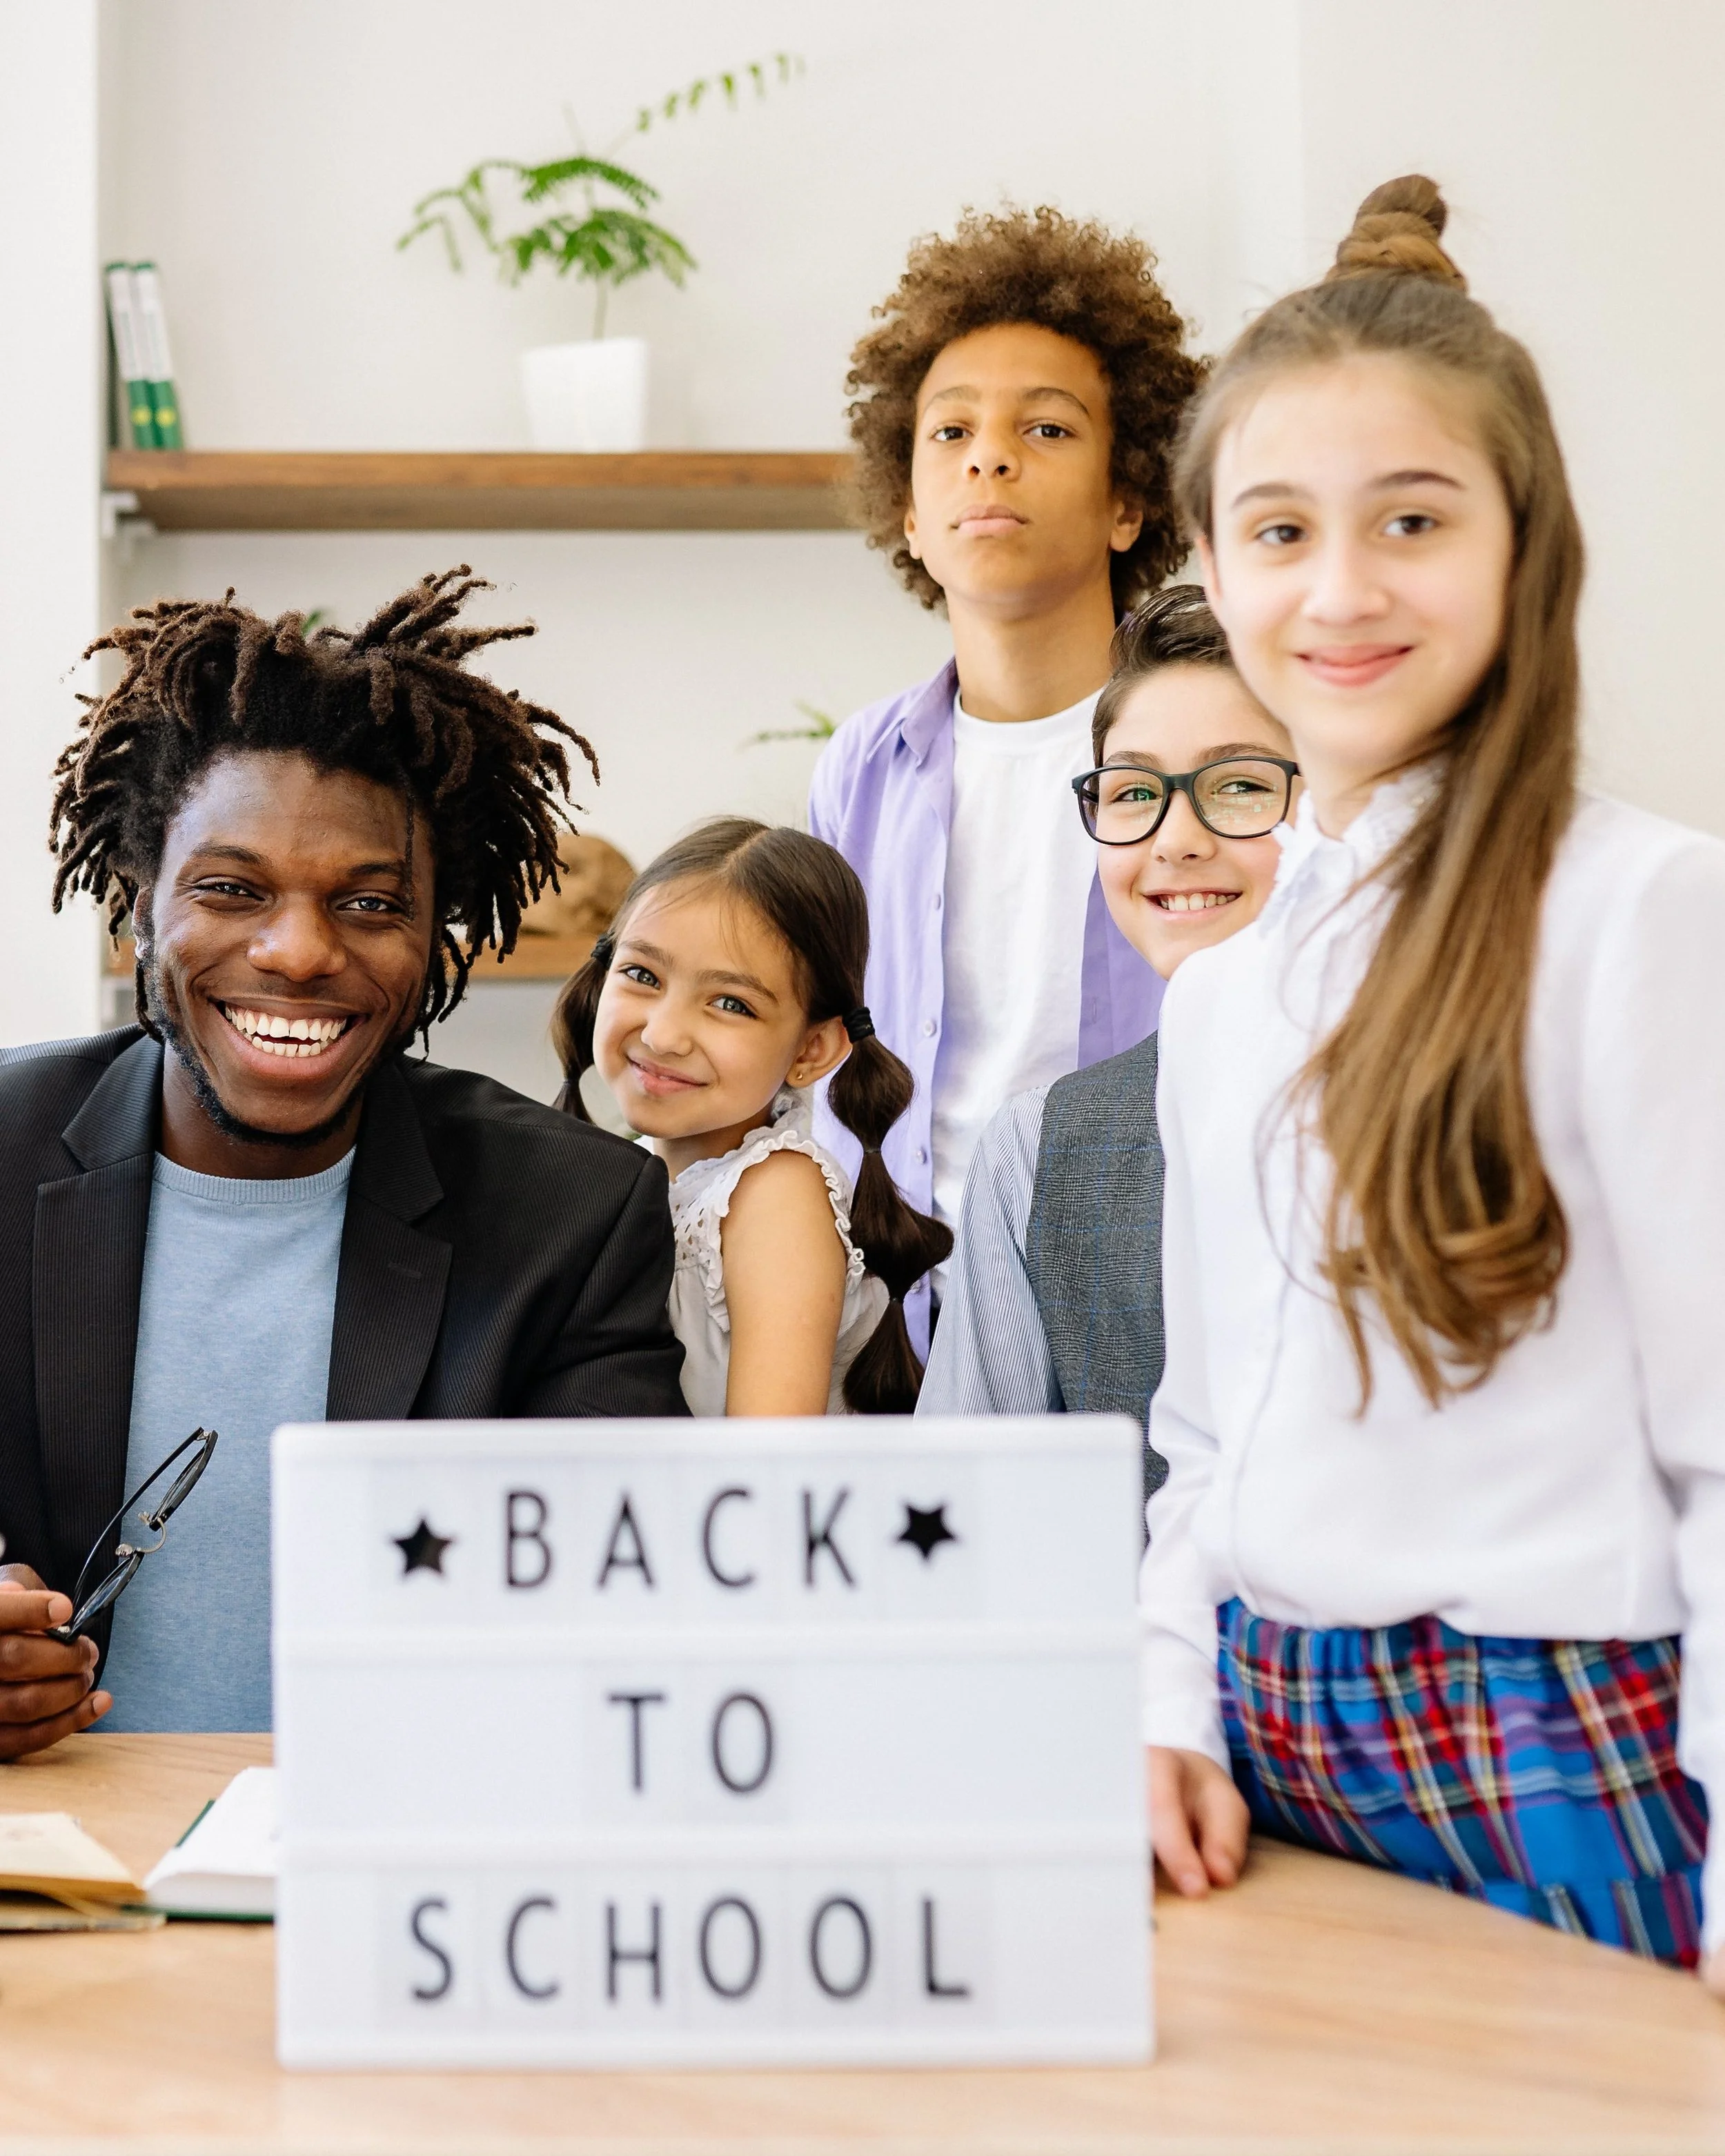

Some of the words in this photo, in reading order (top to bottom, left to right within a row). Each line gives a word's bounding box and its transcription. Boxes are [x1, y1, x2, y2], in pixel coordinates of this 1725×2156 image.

[504, 1487, 857, 1591] BACK
[607, 1690, 776, 1796] TO
[408, 1895, 972, 2004] SCHOOL
